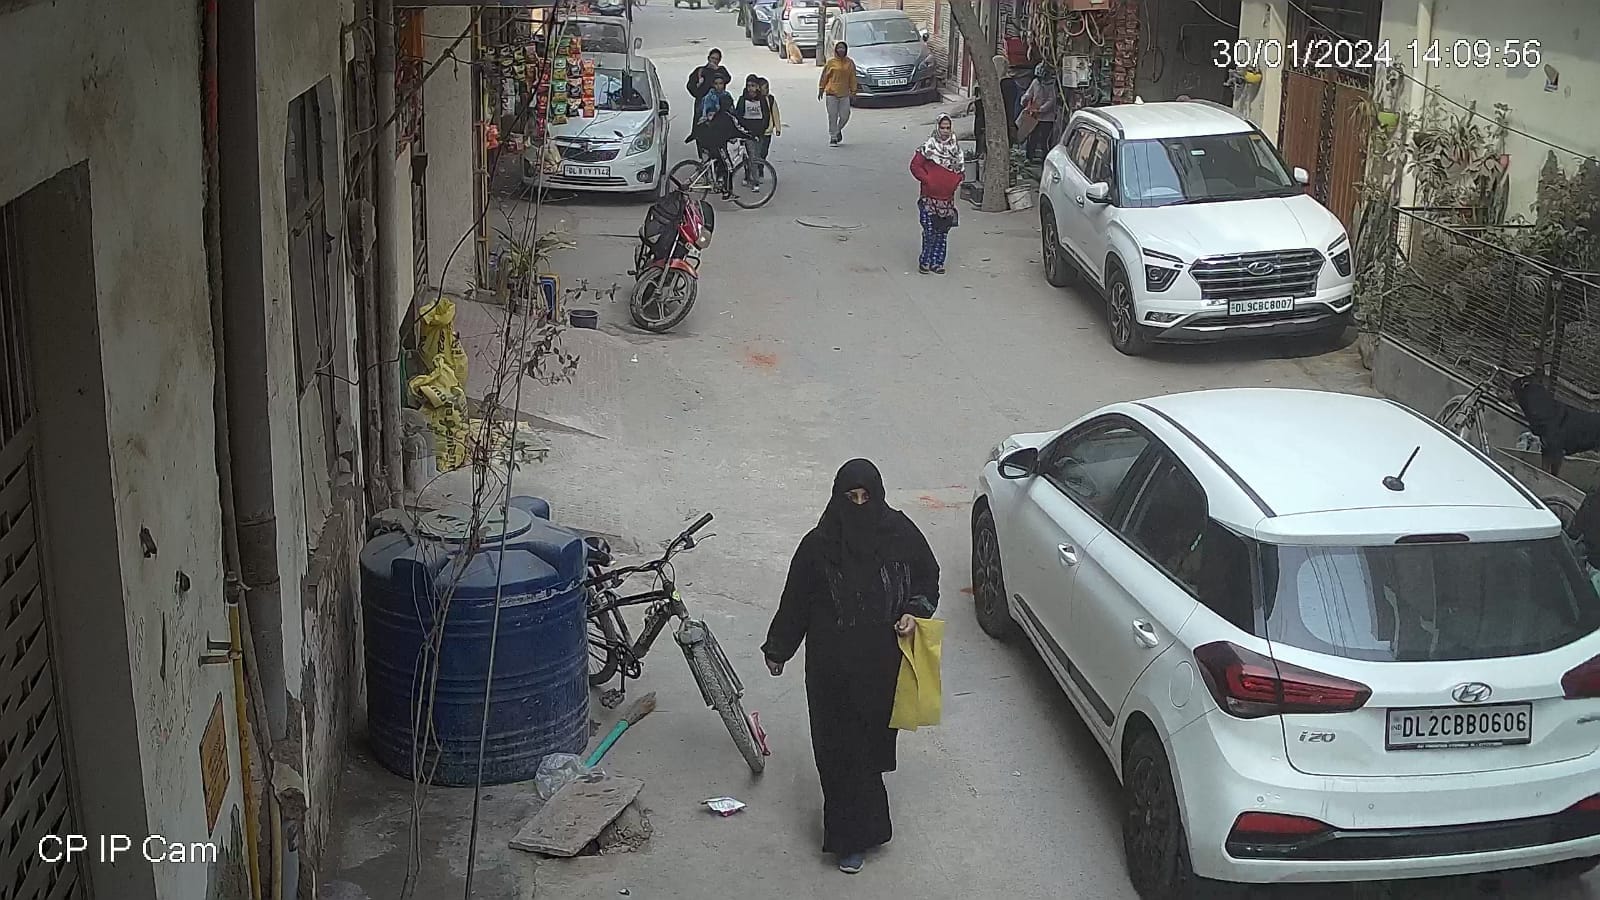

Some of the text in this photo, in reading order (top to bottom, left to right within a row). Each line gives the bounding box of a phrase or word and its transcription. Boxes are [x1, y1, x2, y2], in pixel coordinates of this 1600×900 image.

[1235, 299, 1292, 313] DL9CBC8007
[1402, 712, 1527, 738] DL2CBB0606
[1299, 731, 1336, 742] i20
